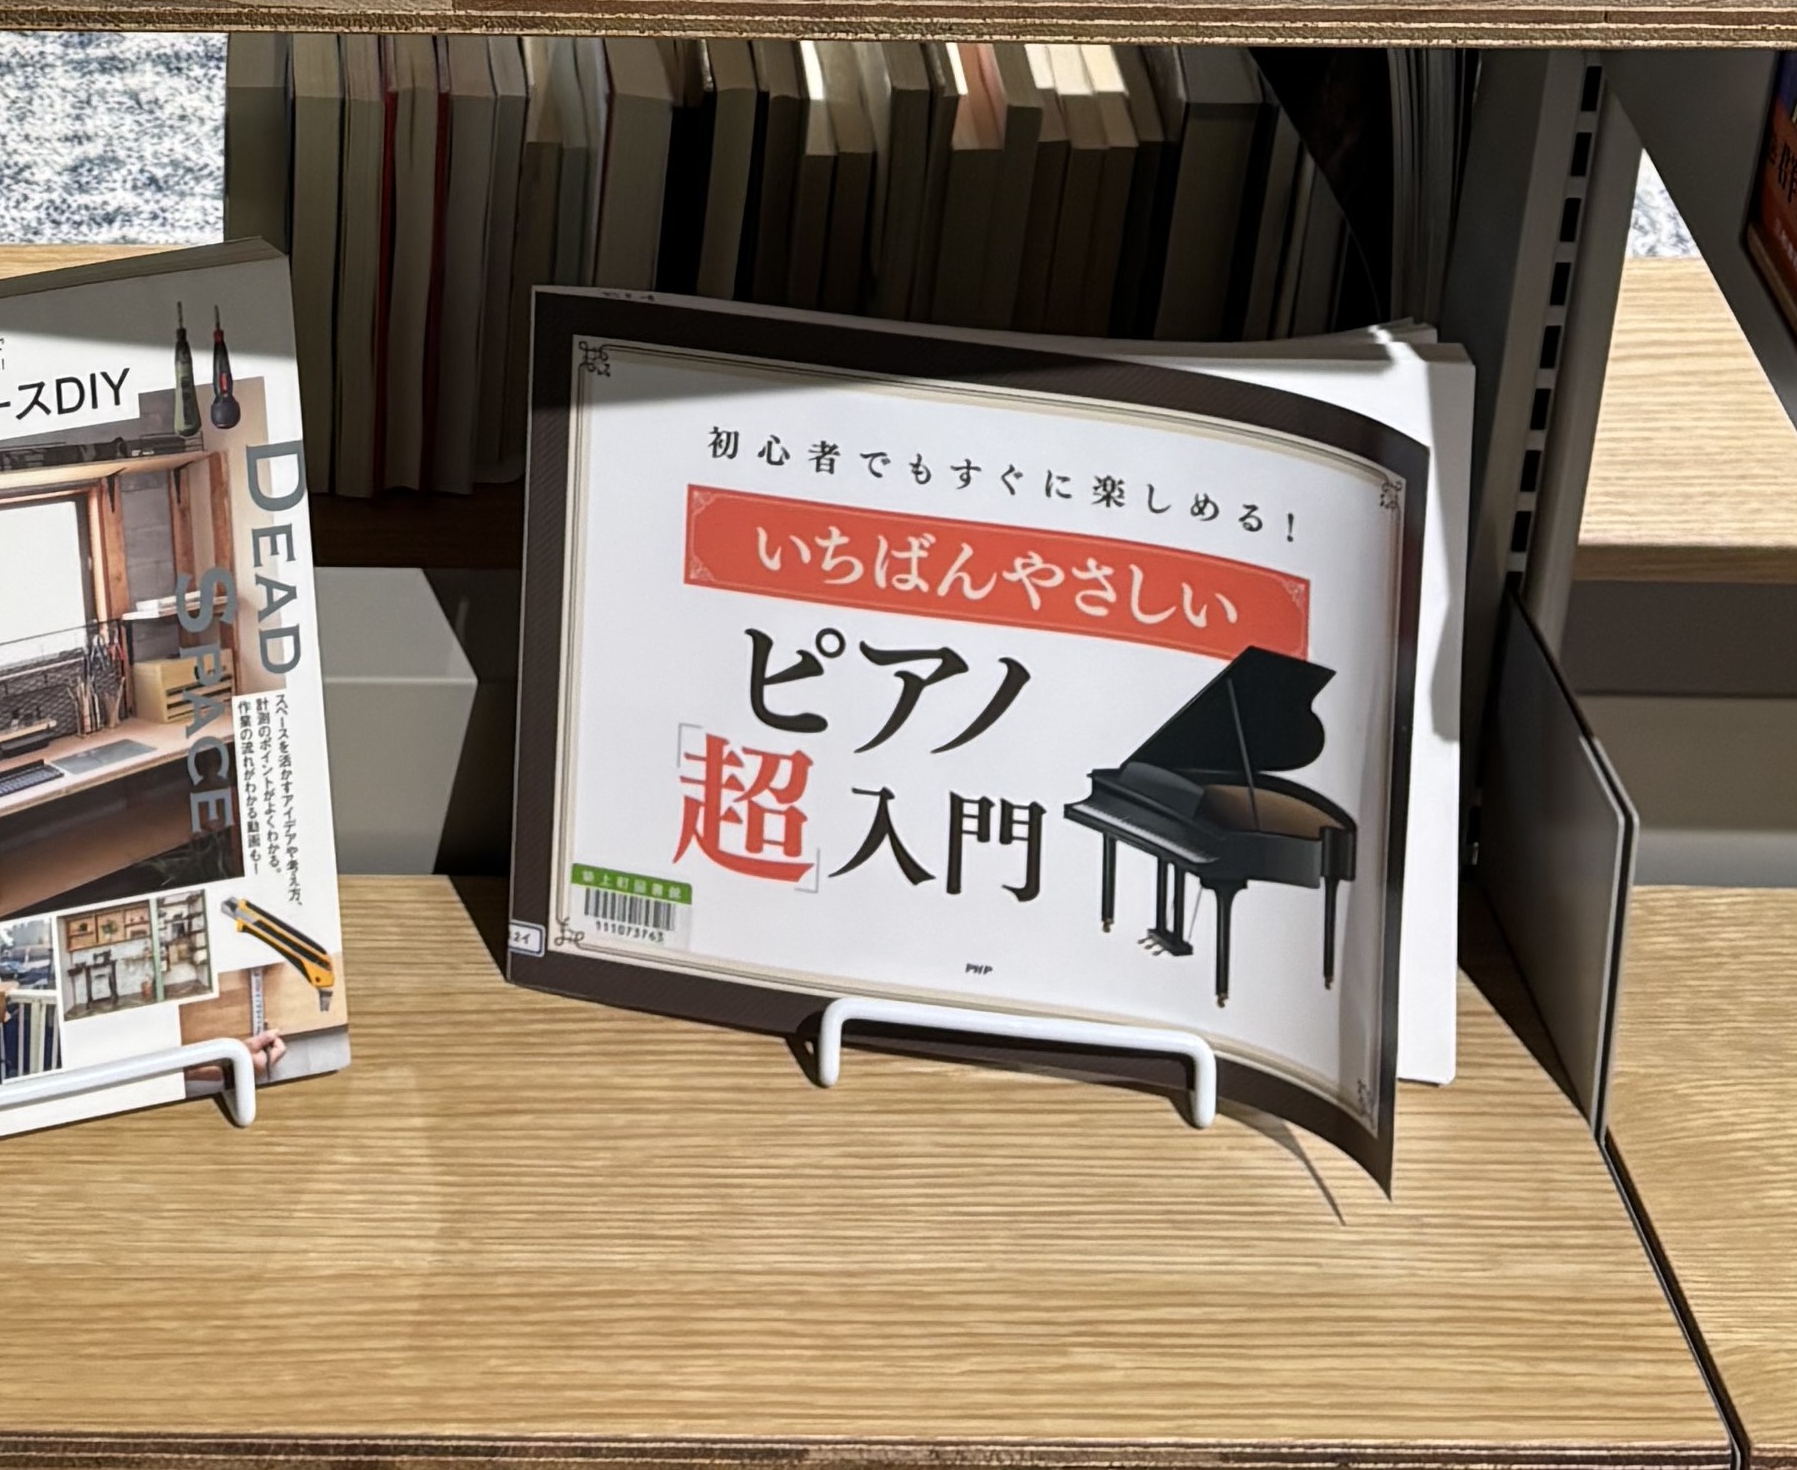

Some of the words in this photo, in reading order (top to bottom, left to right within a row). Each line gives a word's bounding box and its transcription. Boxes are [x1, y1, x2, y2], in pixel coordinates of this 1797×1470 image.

[706, 425, 1297, 543] 初心者でもすぐに楽しめる！
[245, 442, 306, 675] DEAD
[756, 524, 1240, 630] いちばんやさしい
[176, 566, 237, 835] SPACE
[744, 627, 1033, 754] ピアノ
